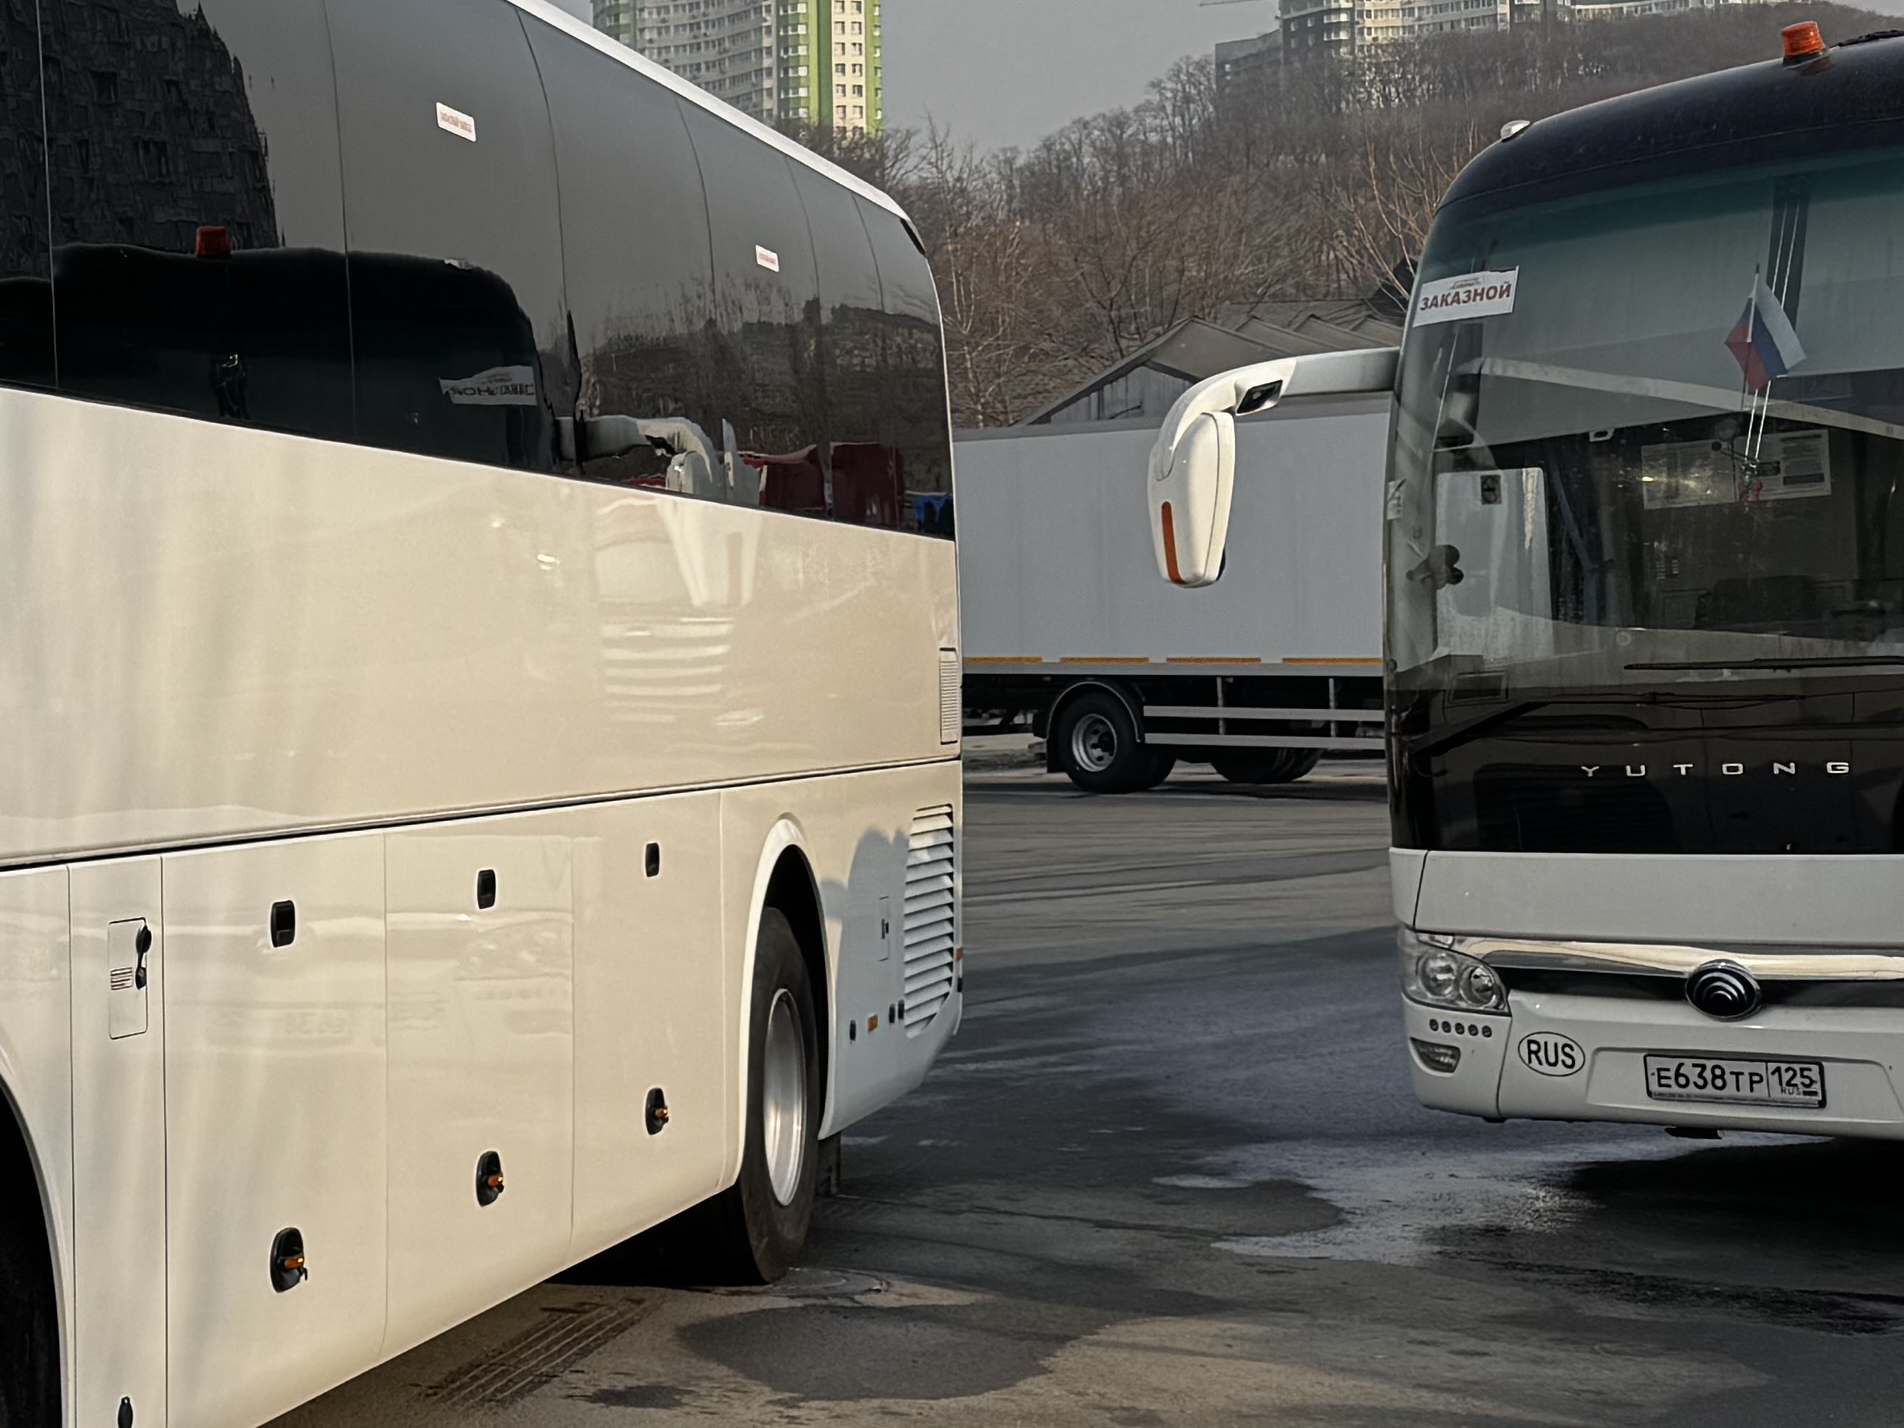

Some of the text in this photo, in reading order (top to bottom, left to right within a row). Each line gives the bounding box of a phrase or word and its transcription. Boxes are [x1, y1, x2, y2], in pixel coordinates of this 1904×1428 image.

[1420, 280, 1512, 311] ЗАКАЗНОЙ
[1580, 761, 1850, 778] YUTONG
[1526, 1038, 1576, 1070] RUS
[1655, 1062, 1816, 1094] Е638ТР 125
